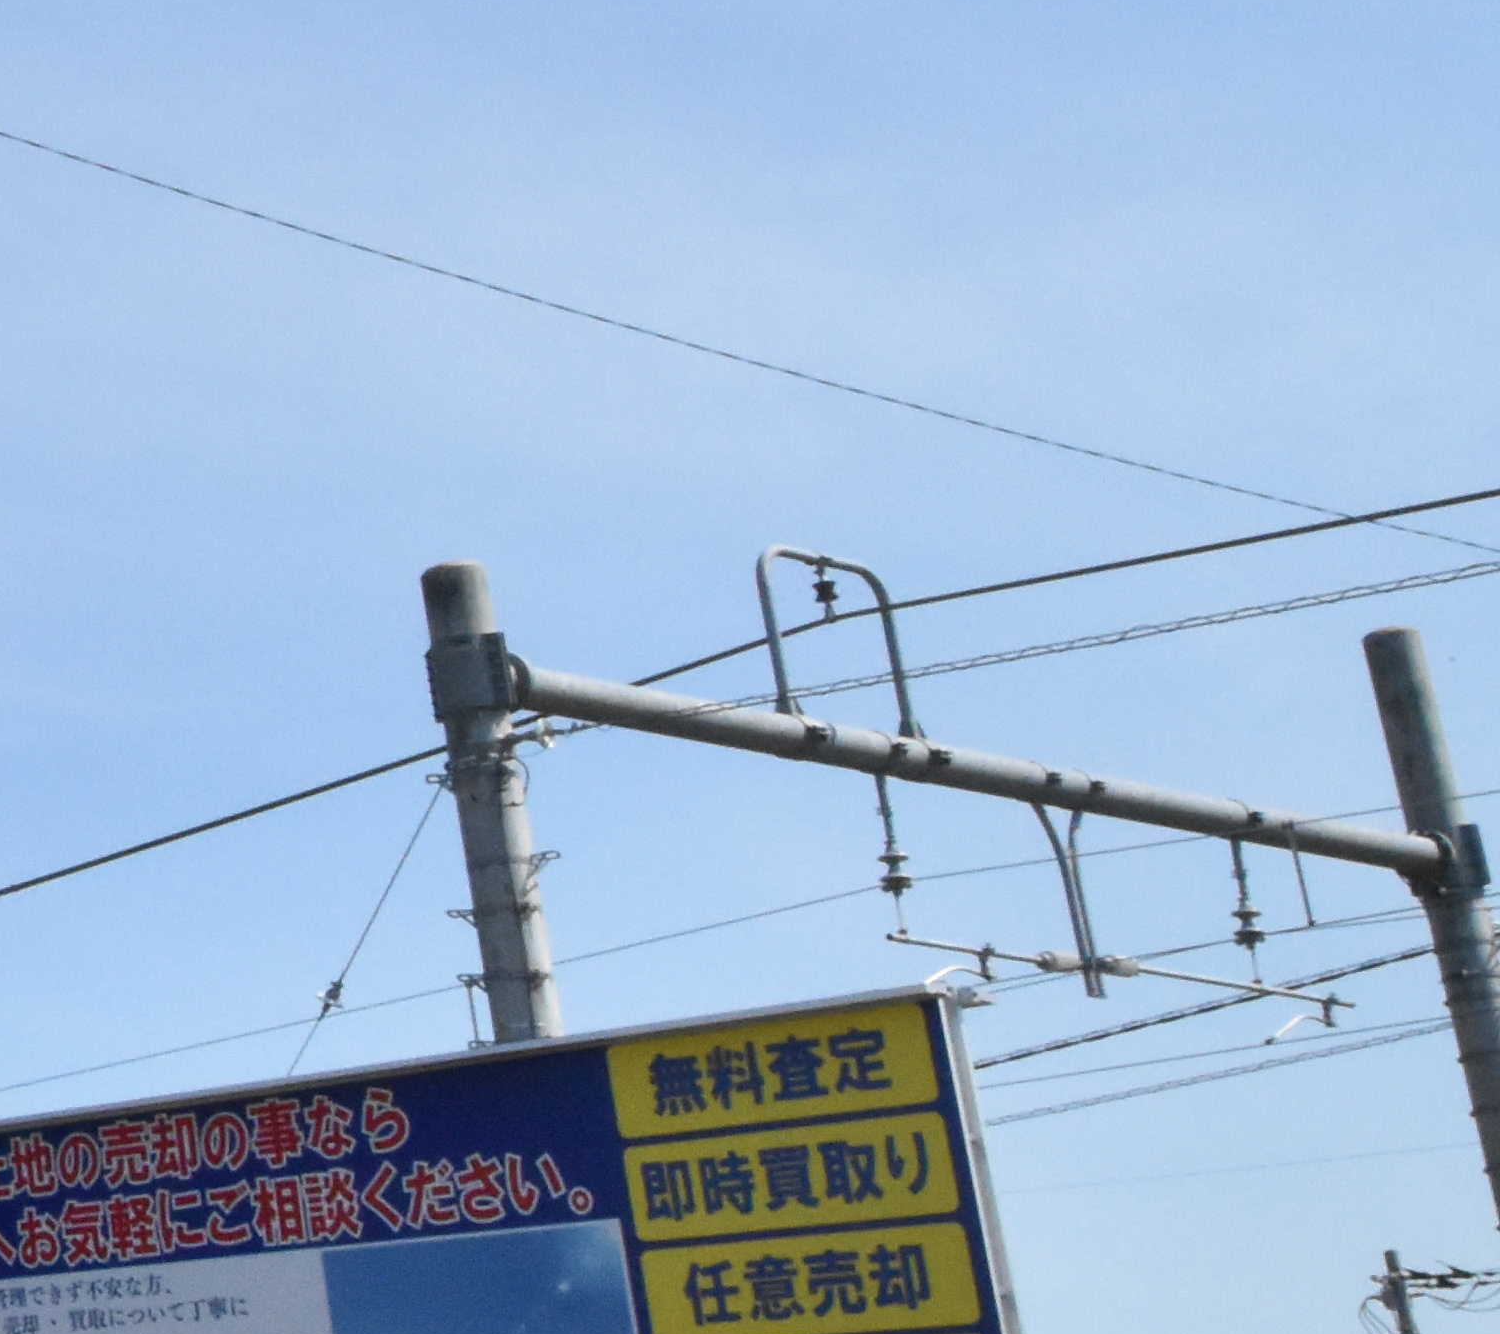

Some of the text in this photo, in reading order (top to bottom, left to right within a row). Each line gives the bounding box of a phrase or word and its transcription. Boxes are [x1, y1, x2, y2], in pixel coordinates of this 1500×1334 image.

[650, 1028, 892, 1116] 無料査定
[641, 1131, 929, 1221] 即時買取り
[684, 1244, 930, 1326] 任意売却
